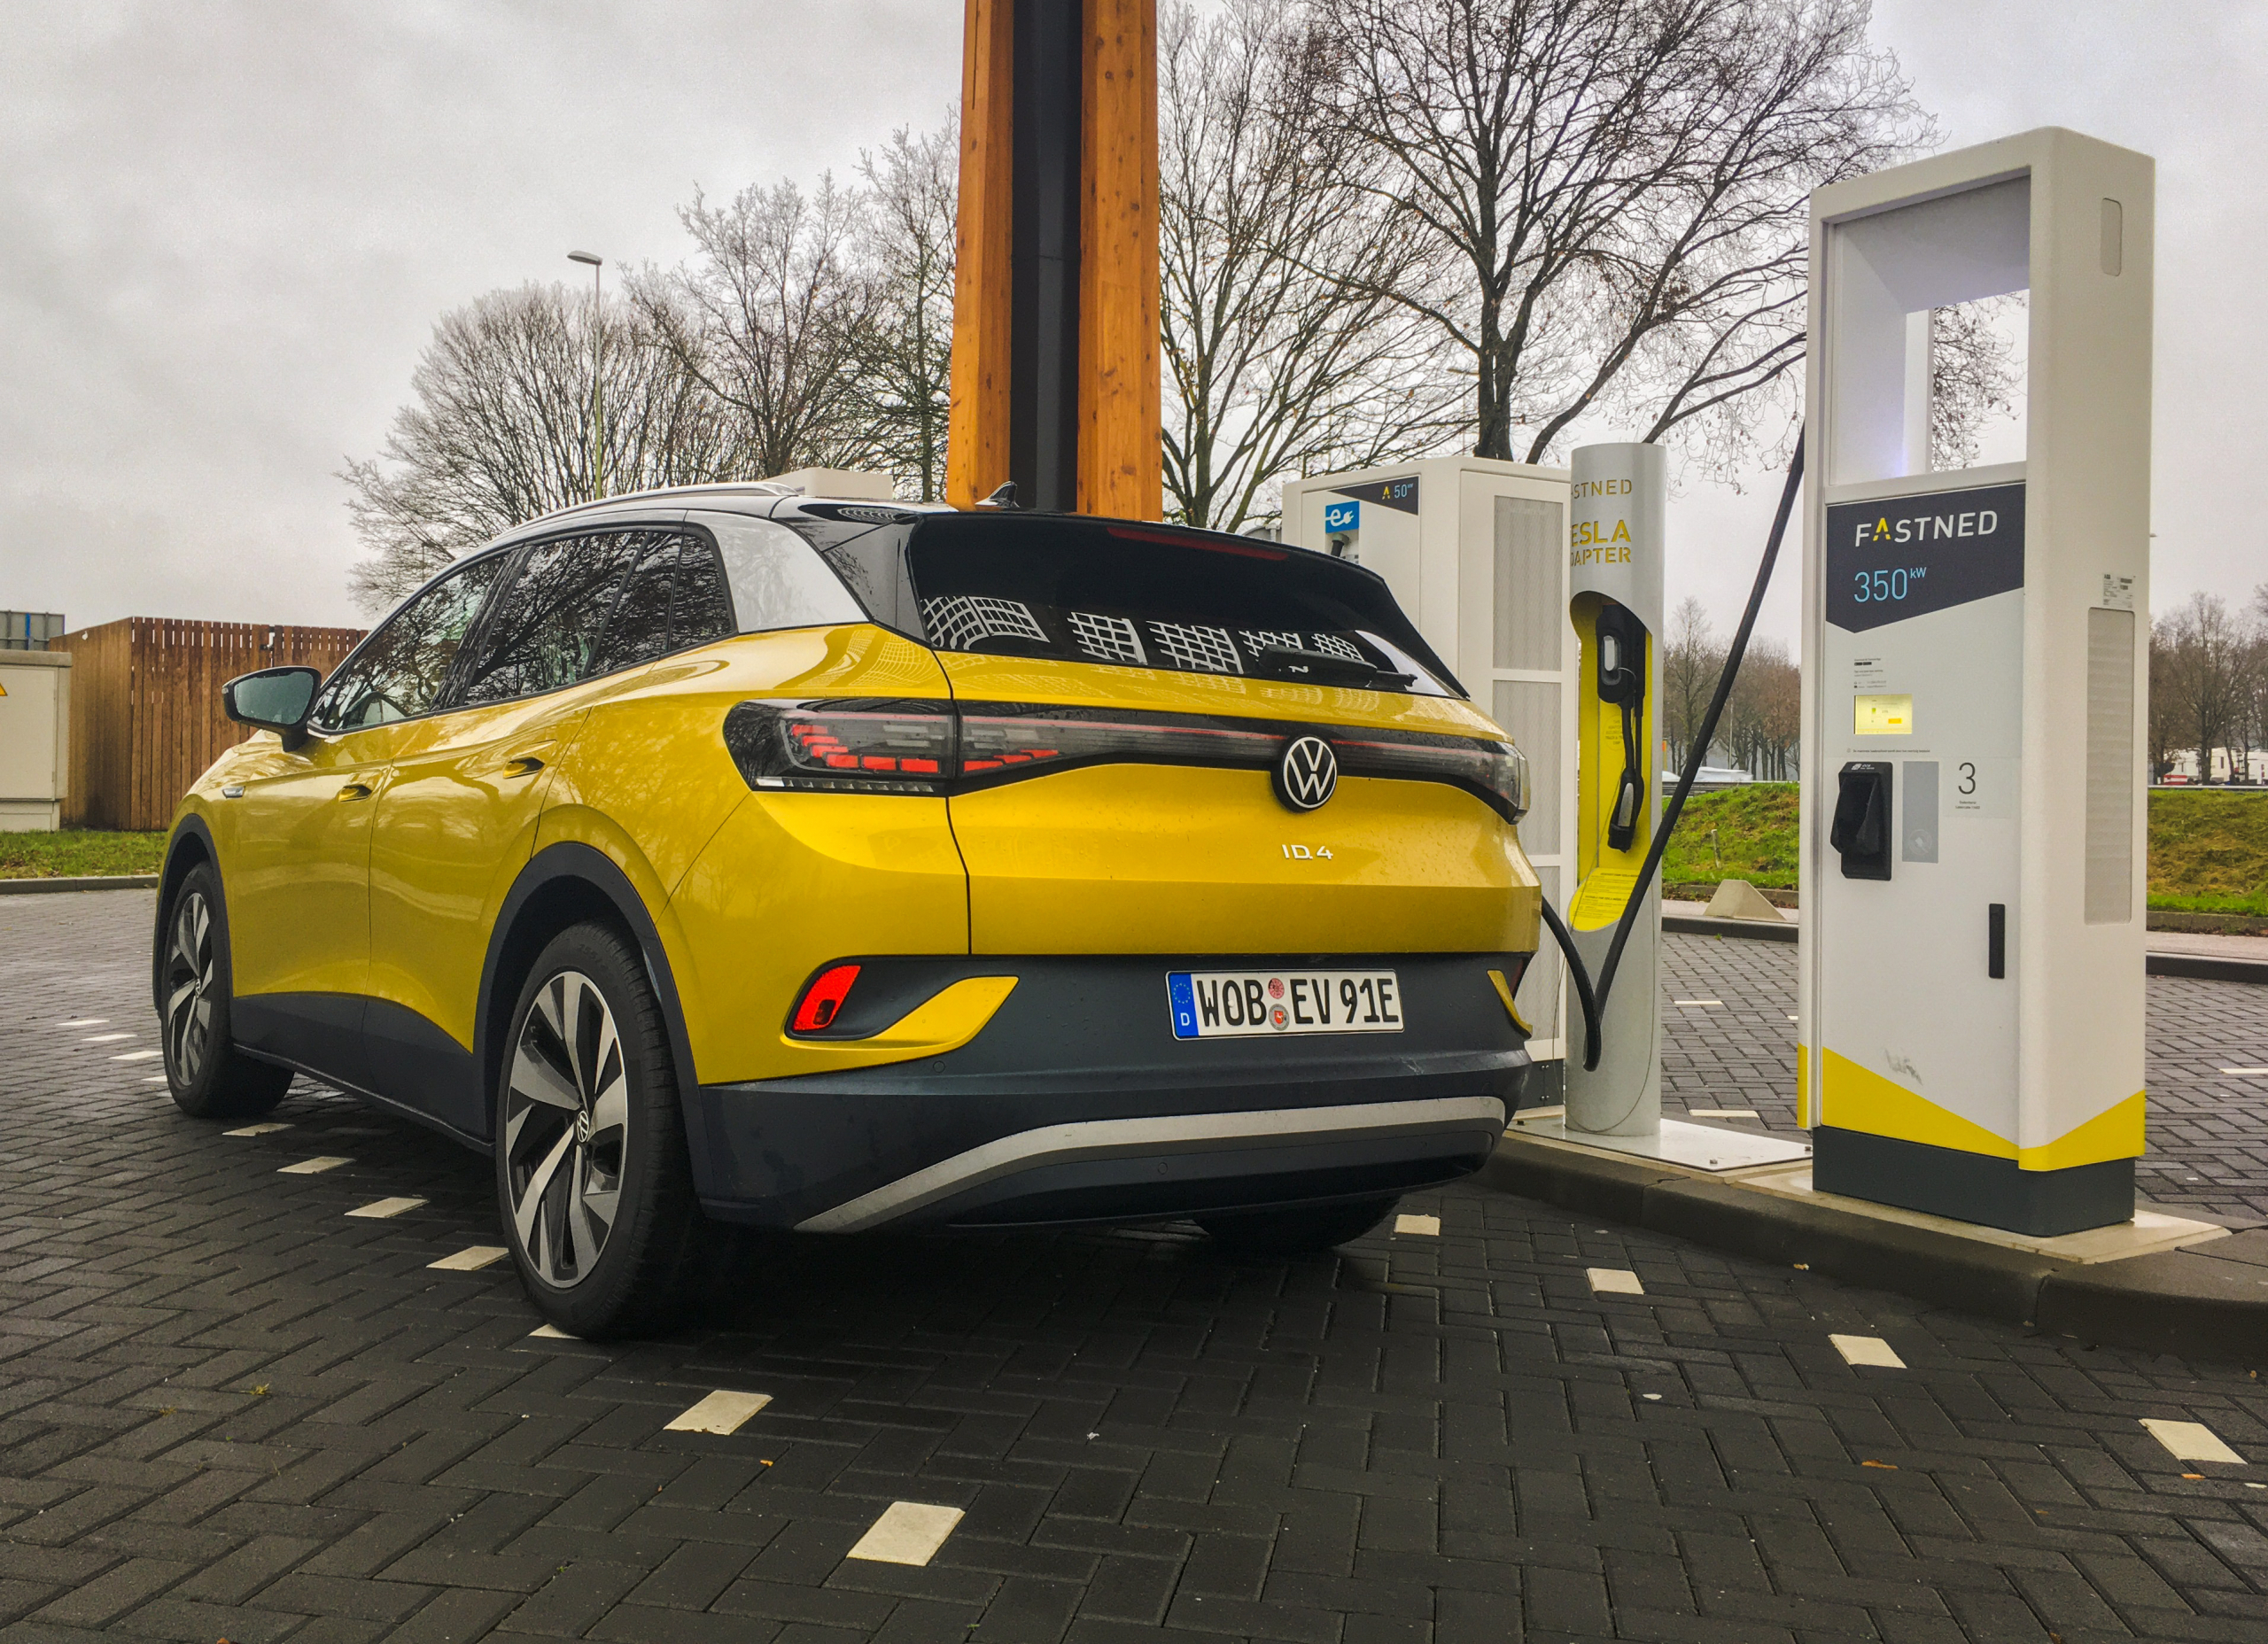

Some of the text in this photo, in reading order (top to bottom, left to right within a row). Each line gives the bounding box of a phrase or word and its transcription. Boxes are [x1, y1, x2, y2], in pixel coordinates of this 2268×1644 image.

[1394, 484, 1407, 498] 50
[1571, 479, 1632, 499] STNED
[1572, 519, 1631, 547] ESLA
[1855, 510, 1997, 547] FASTNED
[1571, 547, 1631, 567] DAPTER
[1958, 762, 1976, 795] 3
[1180, 979, 1399, 1027] D WOB EV 91E
